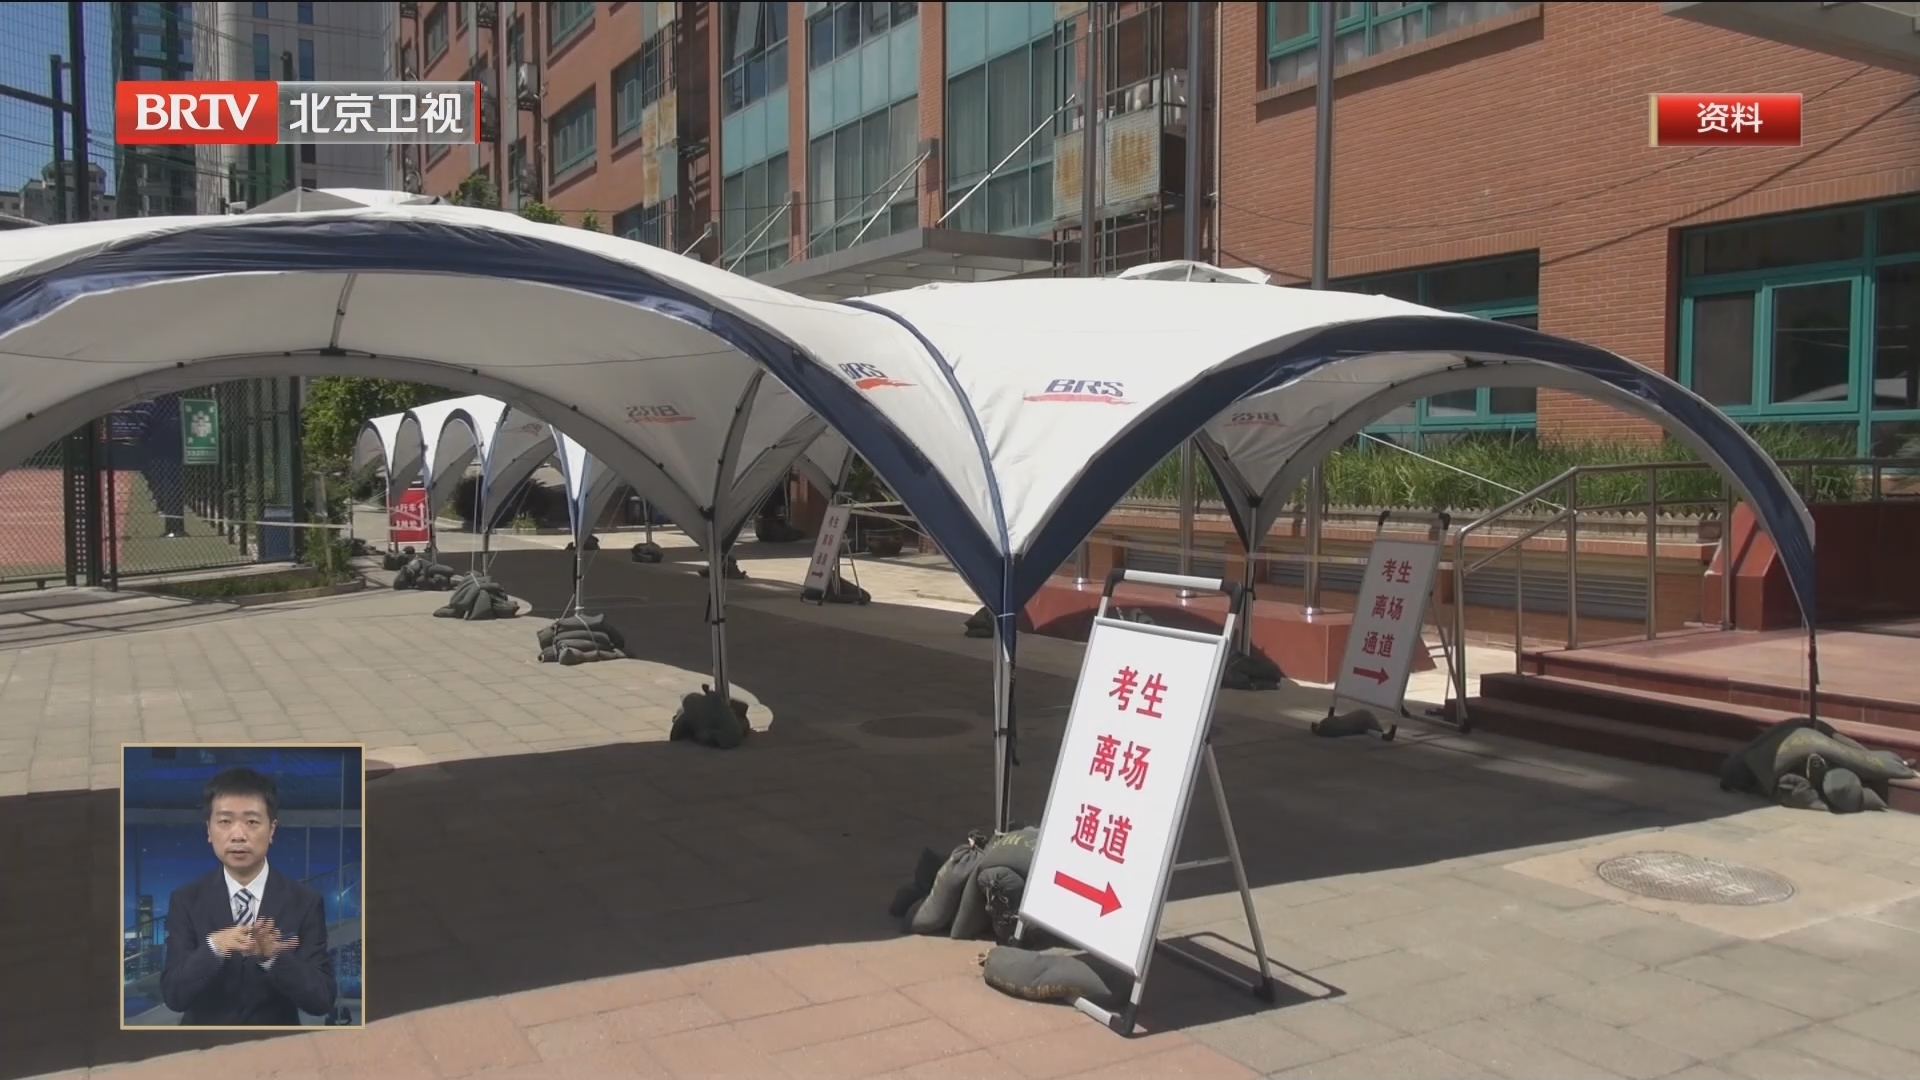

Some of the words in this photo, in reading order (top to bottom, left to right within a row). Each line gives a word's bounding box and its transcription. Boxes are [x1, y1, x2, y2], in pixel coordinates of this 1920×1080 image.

[838, 362, 889, 380] BRS
[1044, 379, 1124, 398] BRS
[1381, 558, 1412, 584] 考生
[1372, 594, 1404, 621] 离场
[1362, 631, 1395, 658] 通道
[1108, 666, 1168, 719] 考生
[1089, 734, 1152, 791] 离场
[1070, 803, 1133, 864] 通道
